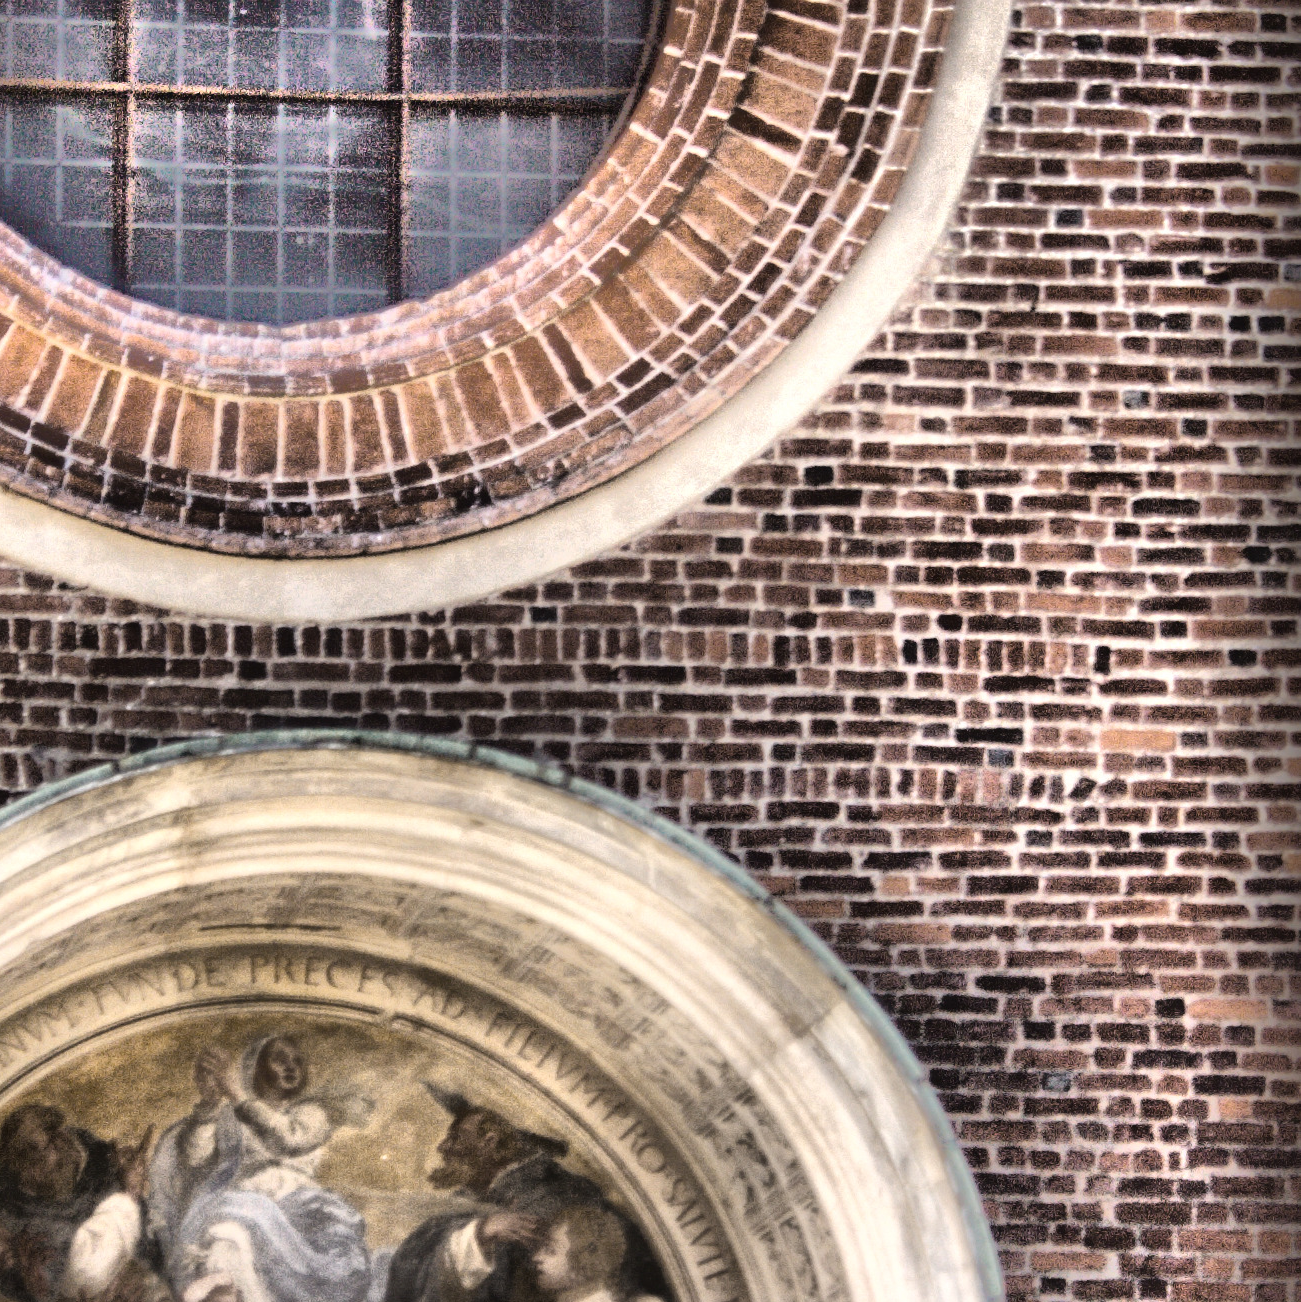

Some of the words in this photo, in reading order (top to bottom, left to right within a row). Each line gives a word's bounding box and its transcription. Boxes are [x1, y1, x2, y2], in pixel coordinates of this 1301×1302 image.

[90, 957, 226, 1015] FVNDE
[250, 954, 398, 997] PRECES
[412, 981, 466, 1019] AD
[486, 1010, 606, 1107] FILIVM
[602, 1100, 667, 1173] PRO
[663, 1178, 733, 1290] SALVTE
